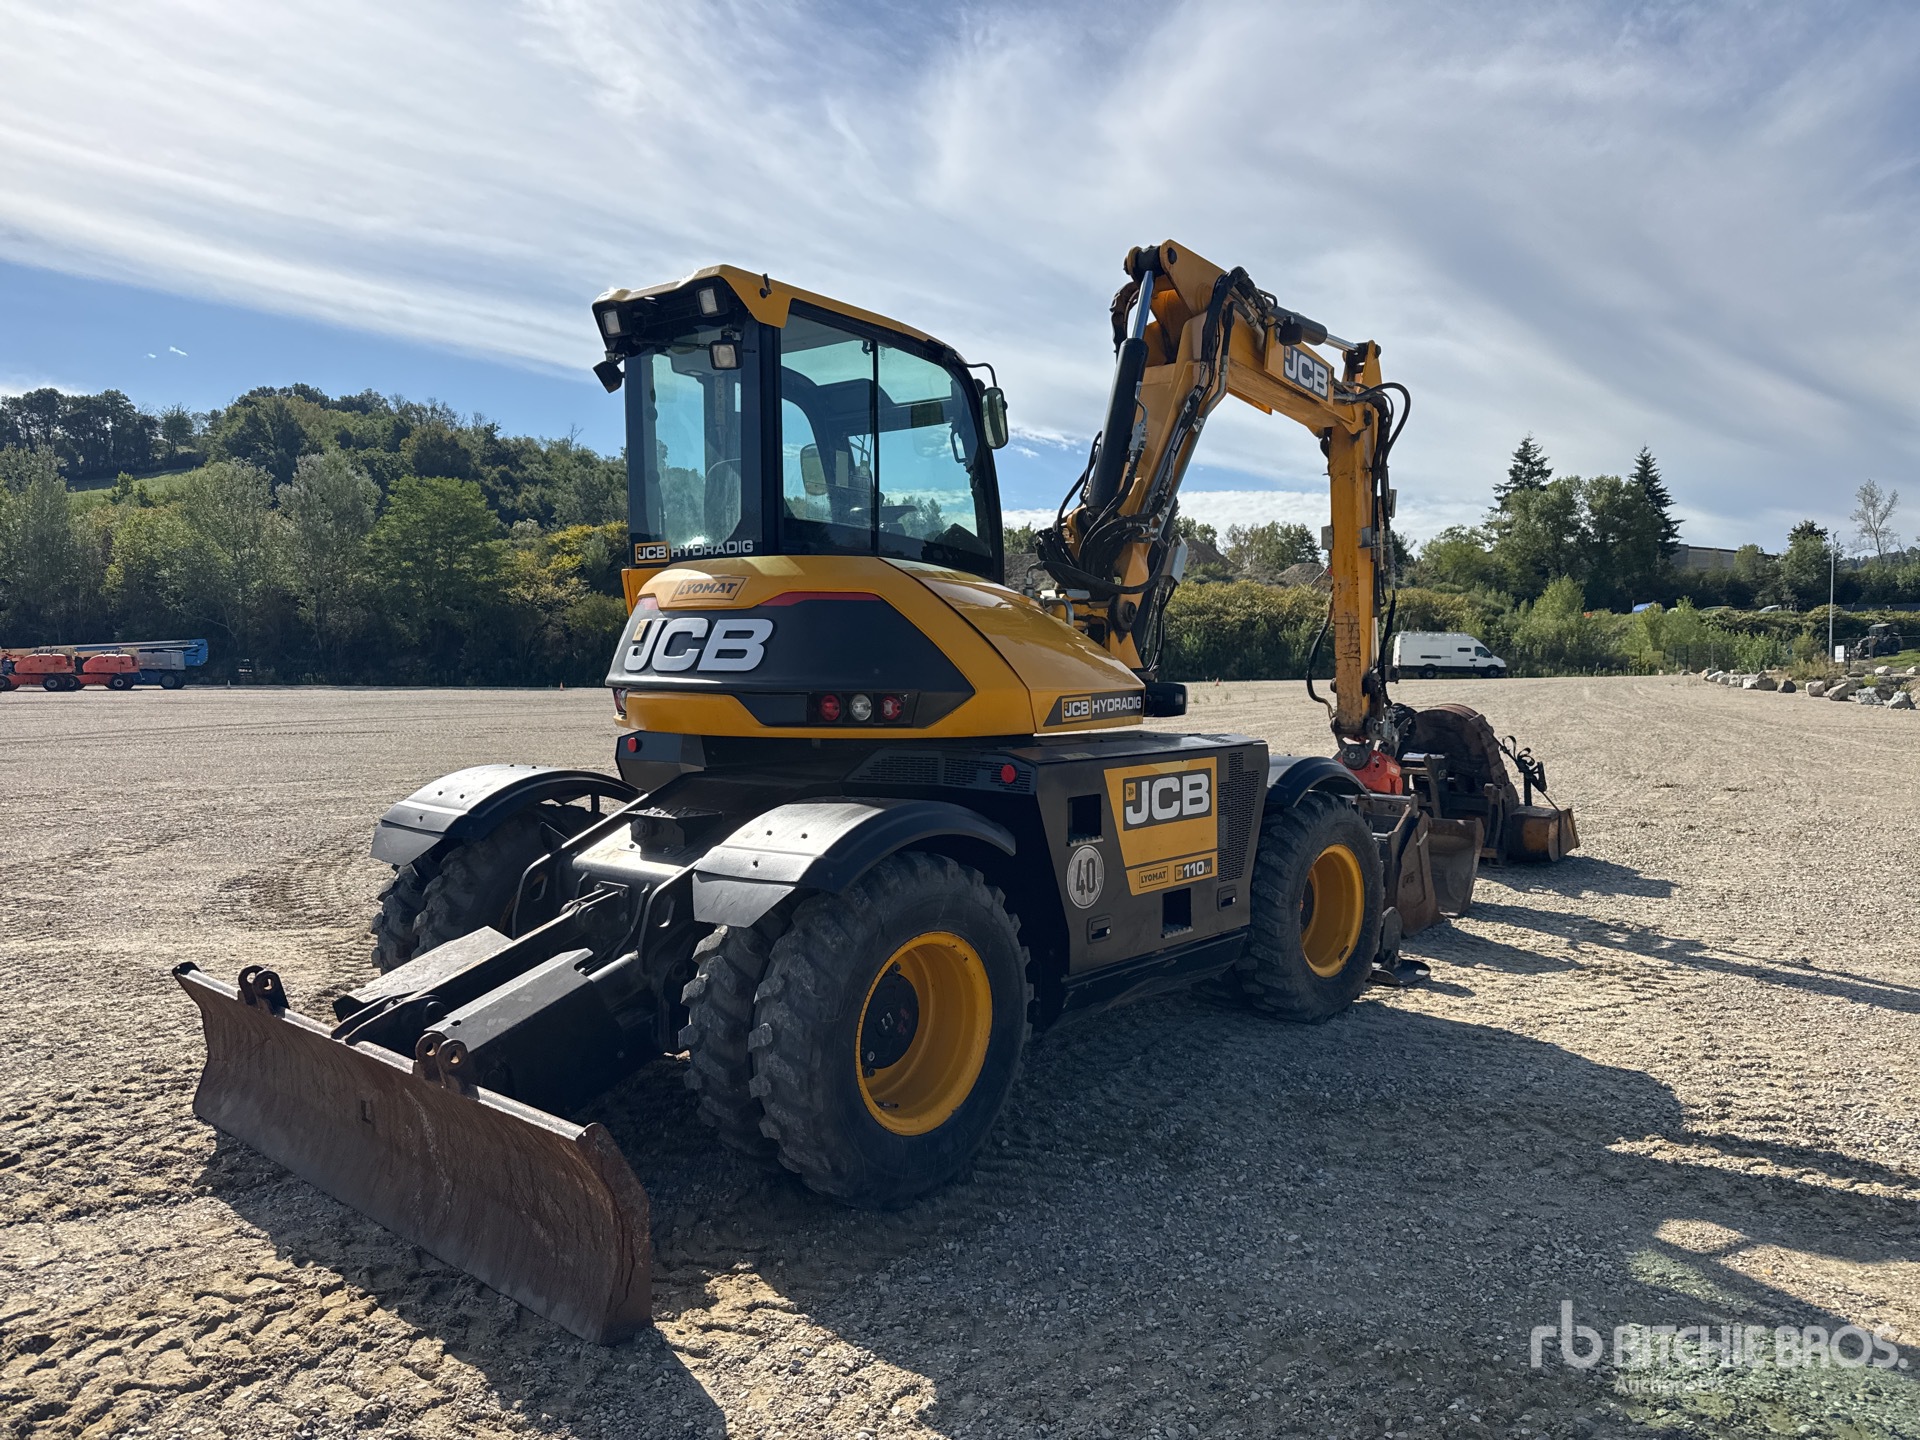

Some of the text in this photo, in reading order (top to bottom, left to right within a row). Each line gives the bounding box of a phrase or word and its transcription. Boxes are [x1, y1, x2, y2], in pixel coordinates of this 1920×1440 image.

[1284, 349, 1328, 397] JCB
[636, 539, 754, 560] JCB HYDRADIG
[678, 582, 738, 596] LYOMAT
[624, 617, 774, 673] JCB
[1064, 696, 1142, 717] JCB HYDRADIG
[1125, 773, 1210, 825] JCB
[1075, 857, 1097, 896] 40
[1140, 871, 1167, 884] LYOMAT
